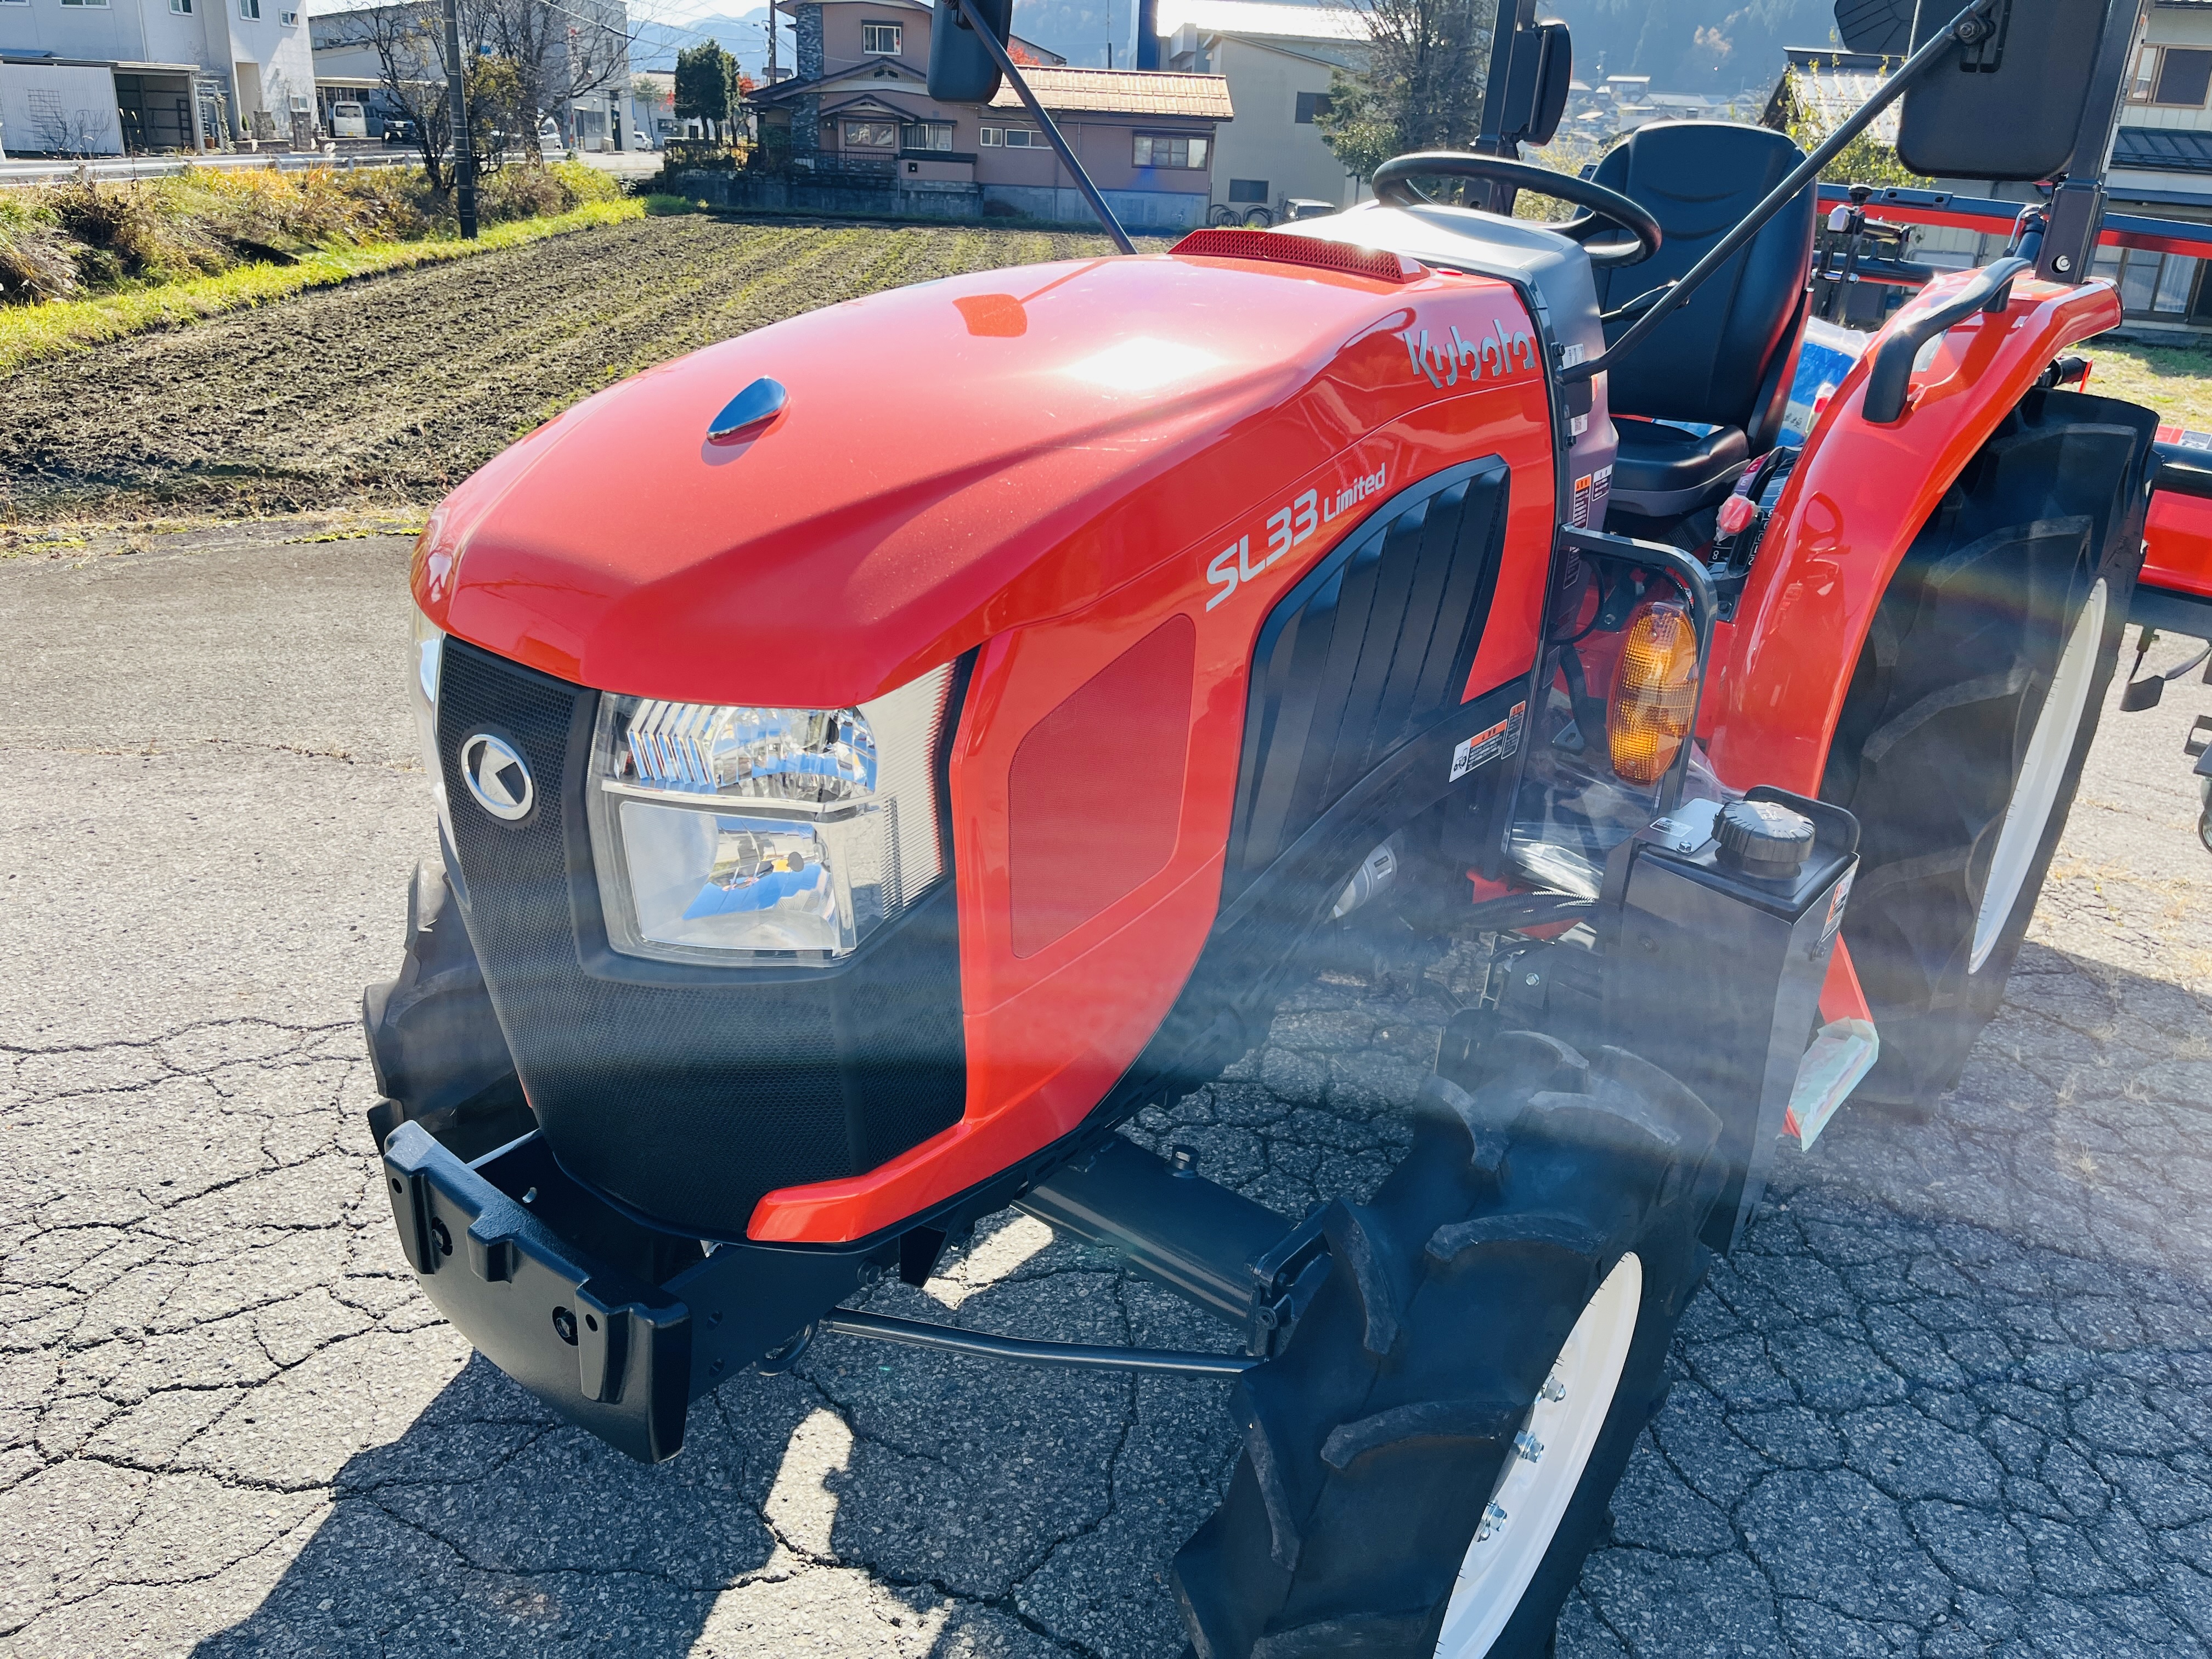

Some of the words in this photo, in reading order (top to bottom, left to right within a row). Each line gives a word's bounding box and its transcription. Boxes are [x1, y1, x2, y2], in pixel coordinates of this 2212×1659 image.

[1403, 319, 1536, 389] Kubota
[1206, 488, 1319, 613] SL33
[1324, 462, 1386, 523] Limited
[1712, 550, 1719, 560] 8
